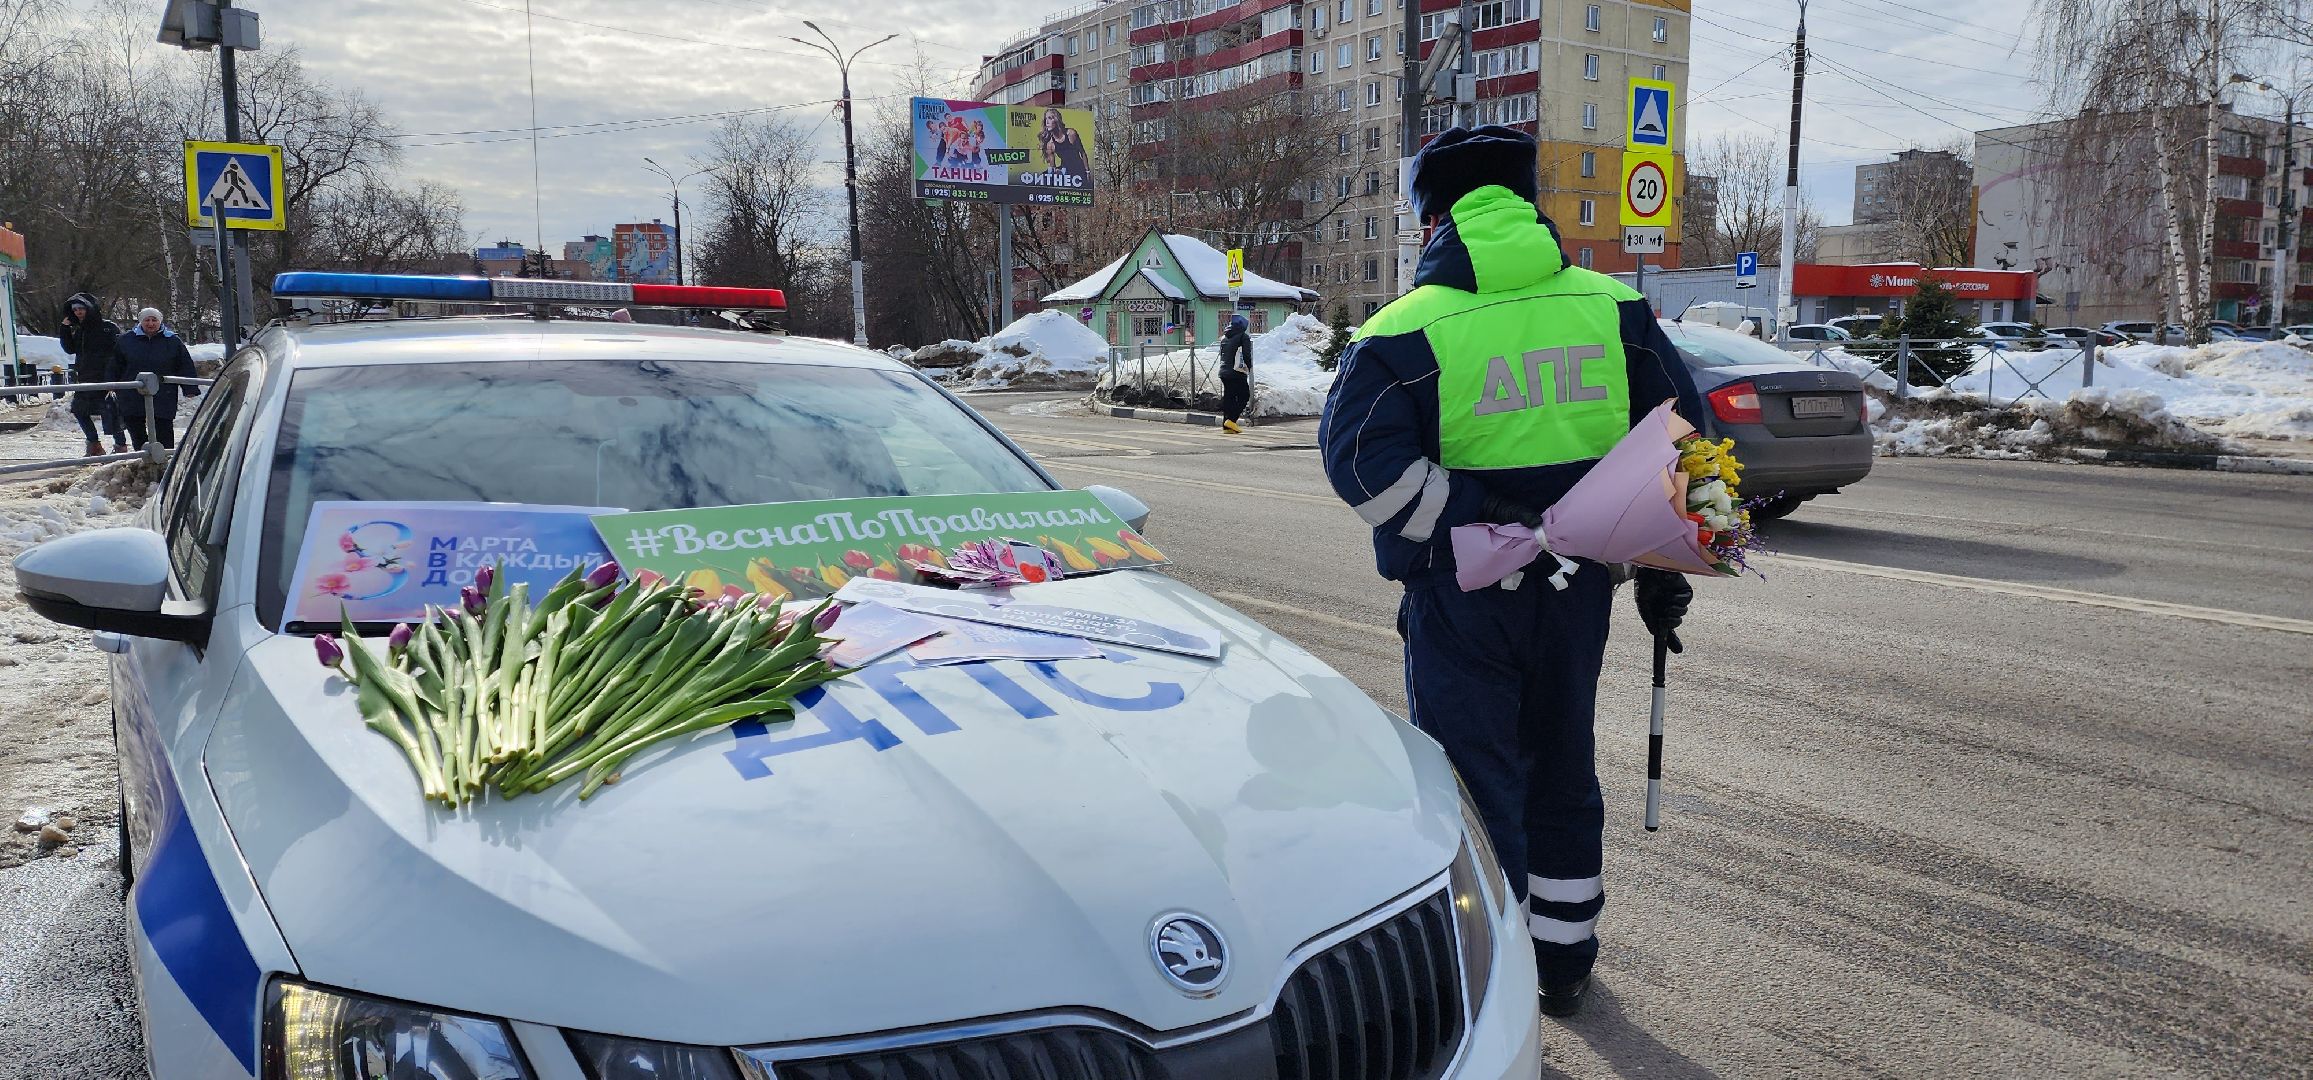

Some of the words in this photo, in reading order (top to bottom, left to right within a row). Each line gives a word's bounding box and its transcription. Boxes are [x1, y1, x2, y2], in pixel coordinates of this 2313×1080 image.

[990, 152, 1026, 162] НАБОР
[932, 167, 988, 181] ТАНЦЫ
[1021, 172, 1082, 187] ФИТНЕС
[1637, 179, 1657, 200] 20
[1633, 234, 1644, 245] 30
[1741, 256, 1752, 275] P
[1474, 344, 1608, 416] ДПС
[625, 507, 1111, 558] #ВеснаПоПравилам
[430, 536, 538, 552] МАРТА
[428, 553, 447, 568] В
[455, 552, 605, 571] КАЖДЫЙ
[421, 570, 473, 588] ДО
